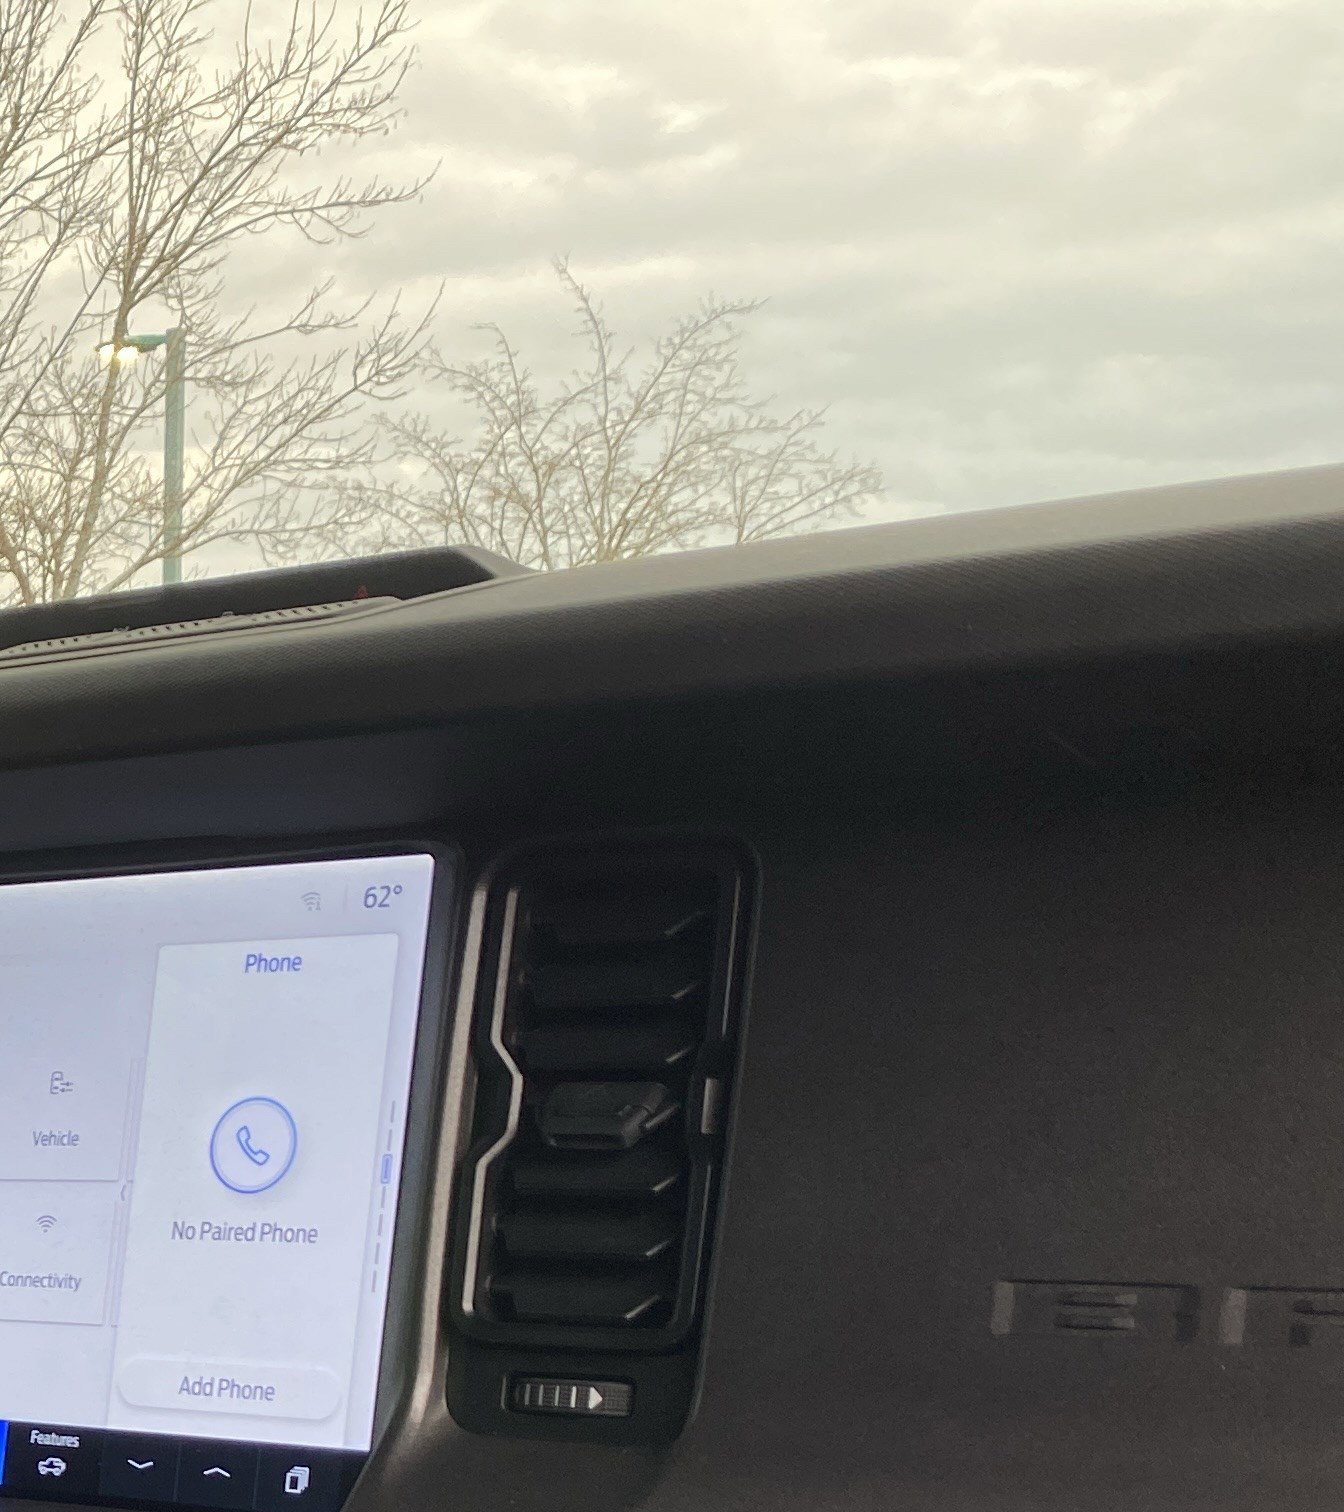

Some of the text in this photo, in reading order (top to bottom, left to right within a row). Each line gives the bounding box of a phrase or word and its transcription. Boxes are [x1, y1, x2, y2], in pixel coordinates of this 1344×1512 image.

[244, 953, 302, 974] Phone
[32, 1130, 80, 1147] Vehicle
[171, 1220, 319, 1244] No Paired Phone
[178, 1375, 276, 1402] Add Phone
[29, 1429, 80, 1448] Features
